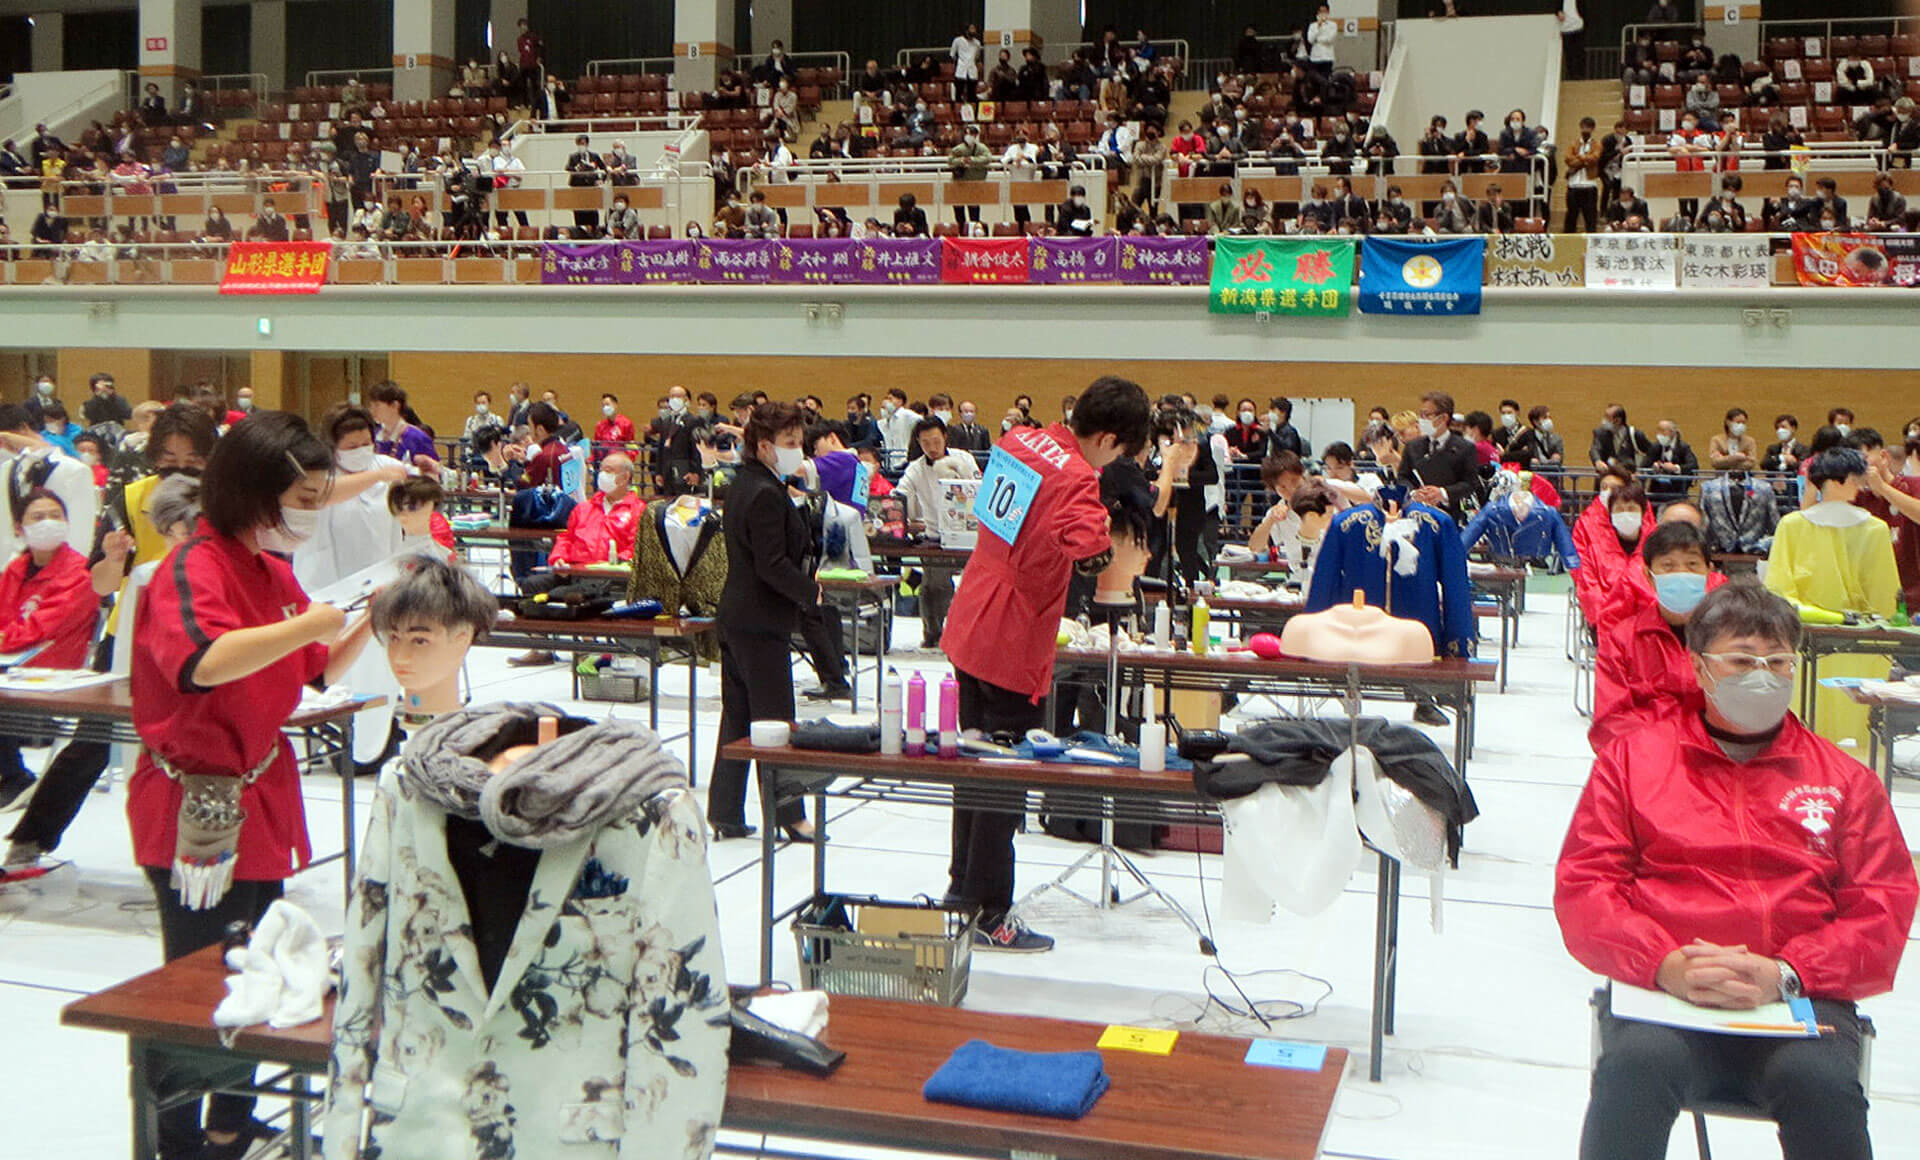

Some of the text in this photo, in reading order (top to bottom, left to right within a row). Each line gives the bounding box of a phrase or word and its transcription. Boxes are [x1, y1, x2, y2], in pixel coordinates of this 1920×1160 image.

[1589, 237, 1676, 251] 東京都代表
[1684, 243, 1770, 258] 東京都代表
[229, 250, 327, 277] 山形県選手団
[1231, 248, 1337, 284] 必勝
[1219, 287, 1339, 309] 新潟県選手団
[987, 475, 1016, 519] 10
